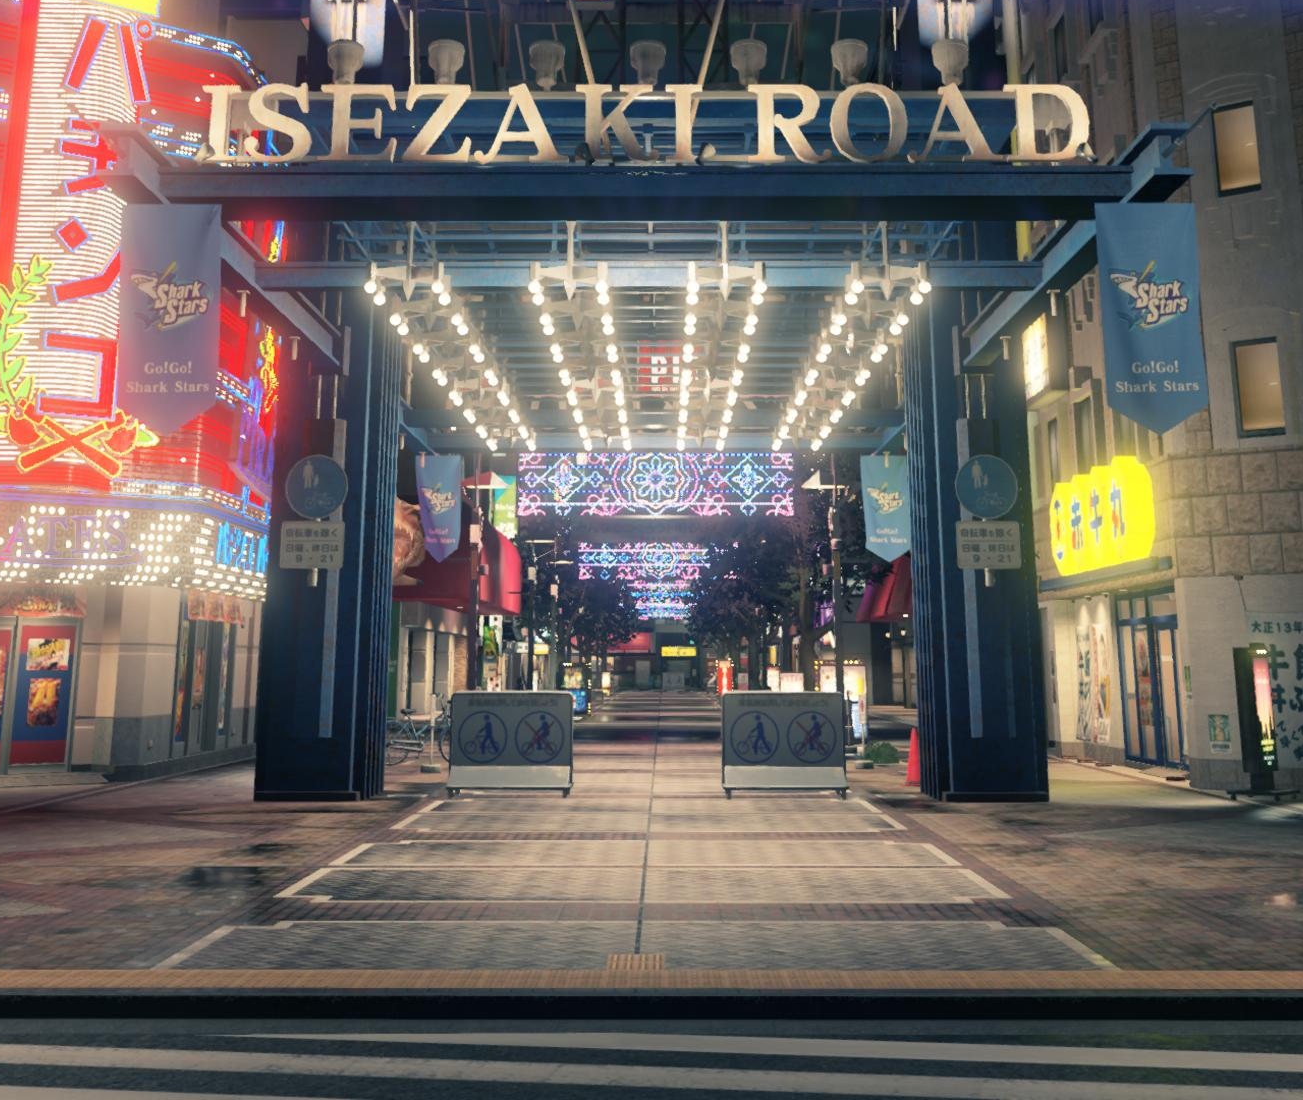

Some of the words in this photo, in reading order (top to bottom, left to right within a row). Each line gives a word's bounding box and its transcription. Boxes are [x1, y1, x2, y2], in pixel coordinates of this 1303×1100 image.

[202, 82, 706, 165] ISEZAKI
[746, 82, 1094, 165] ROAD
[154, 281, 202, 309] Shark
[1136, 280, 1182, 309] Shark
[162, 298, 209, 324] Stars
[1145, 297, 1189, 324] Stars
[174, 380, 210, 393] Stars
[1115, 380, 1157, 393] Shark
[1163, 380, 1200, 393] Stars
